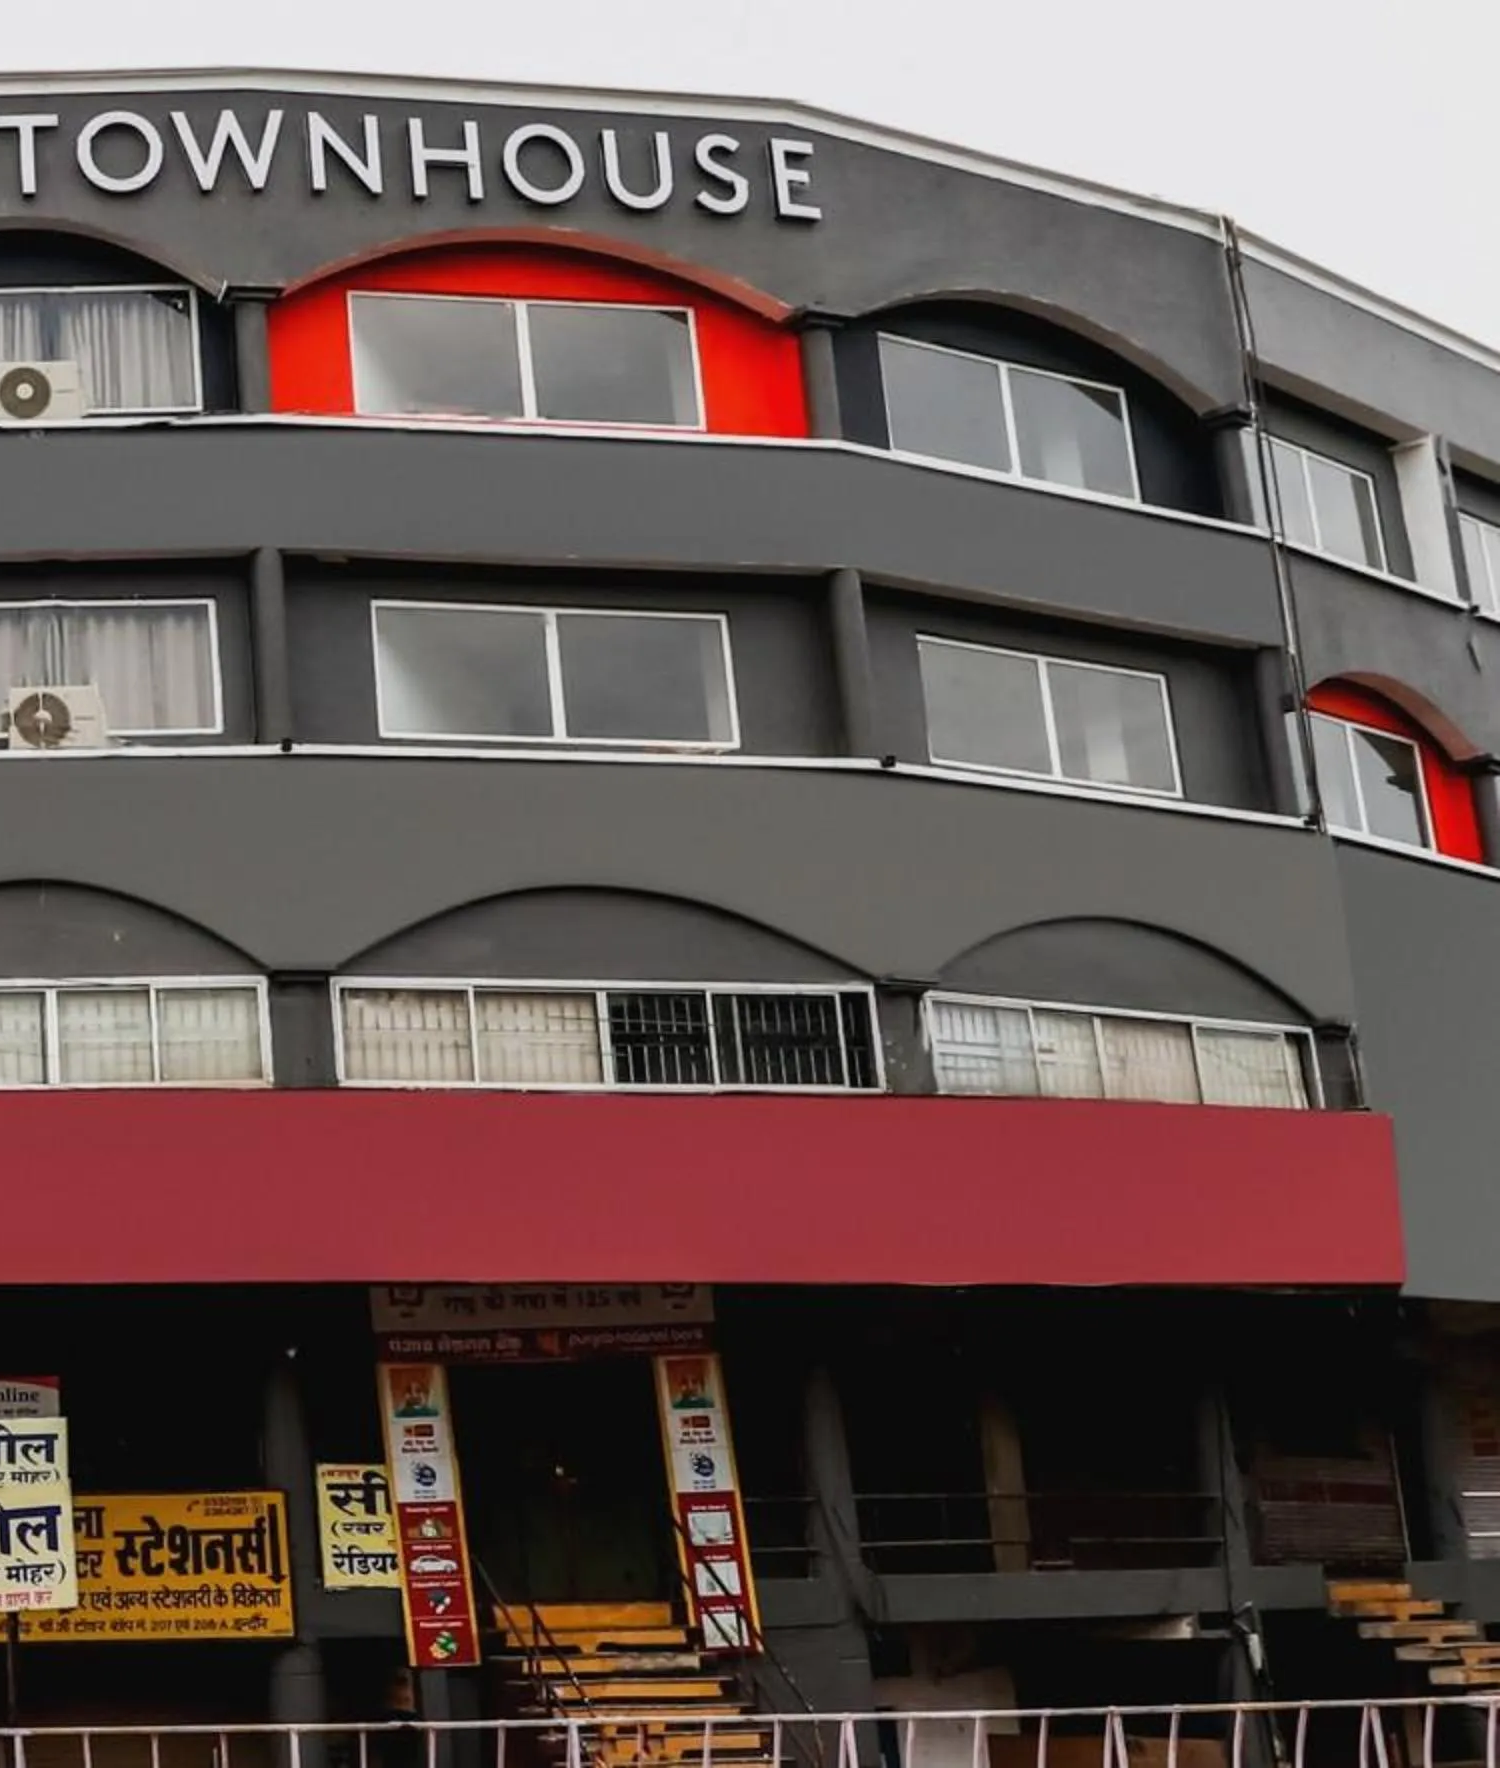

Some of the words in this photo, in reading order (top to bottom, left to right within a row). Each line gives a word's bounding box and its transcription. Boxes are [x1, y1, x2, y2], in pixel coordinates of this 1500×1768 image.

[326, 1470, 393, 1516] सी
[113, 1515, 267, 1577] स्टेशनर्स
[5, 1557, 67, 1586] मोहर)
[151, 1583, 212, 1609] स्टेशनरी
